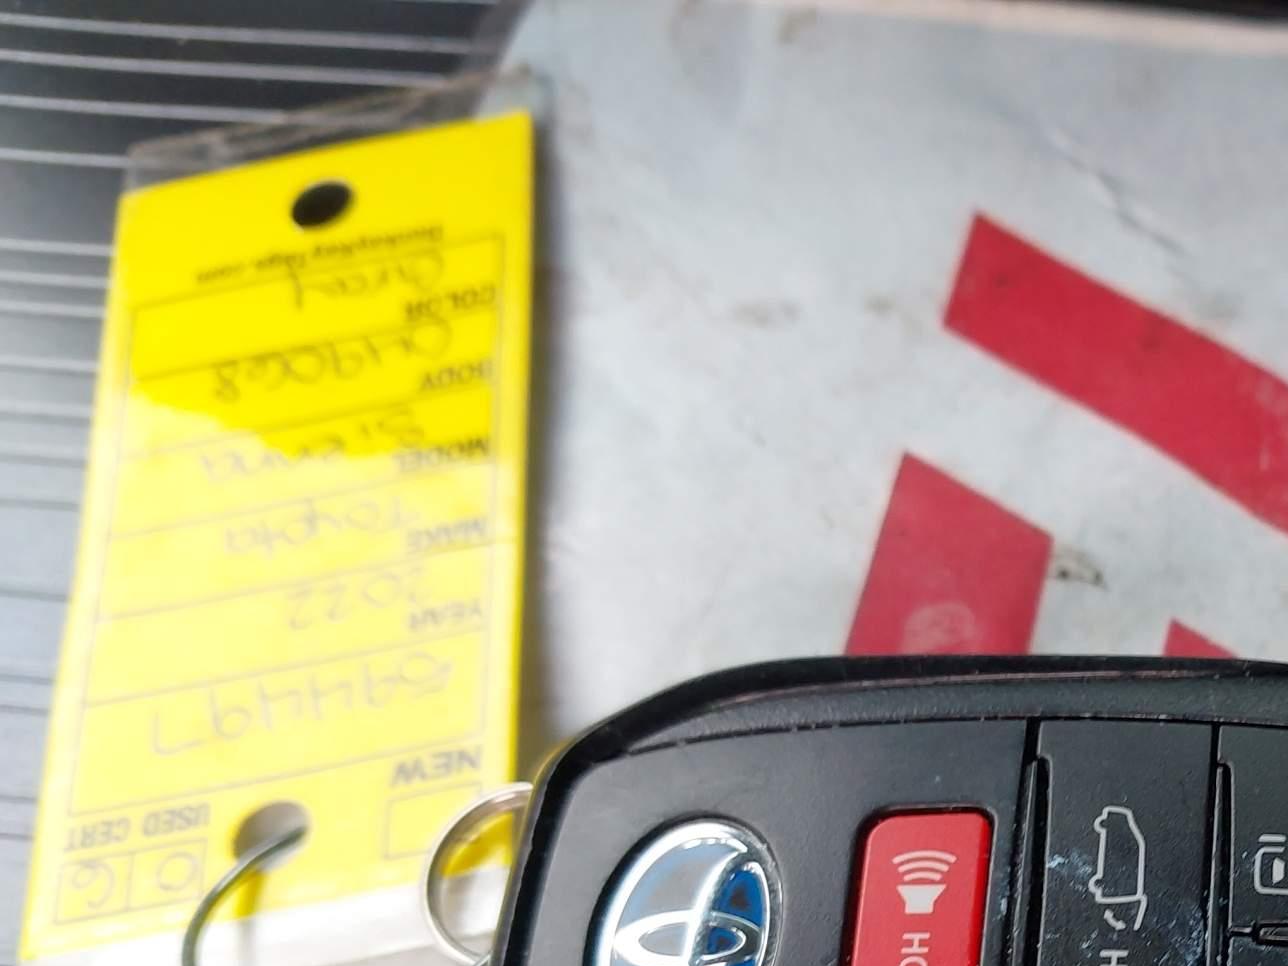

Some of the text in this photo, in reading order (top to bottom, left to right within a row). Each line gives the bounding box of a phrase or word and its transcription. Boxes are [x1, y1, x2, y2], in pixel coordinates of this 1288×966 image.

[404, 284, 497, 323] COLOR
[419, 359, 493, 391] BODY
[394, 436, 491, 475] MODEL
[405, 518, 489, 554] MAKE
[408, 600, 483, 632] YEAR
[390, 746, 481, 786] NEW
[65, 803, 210, 851] USED CERT
